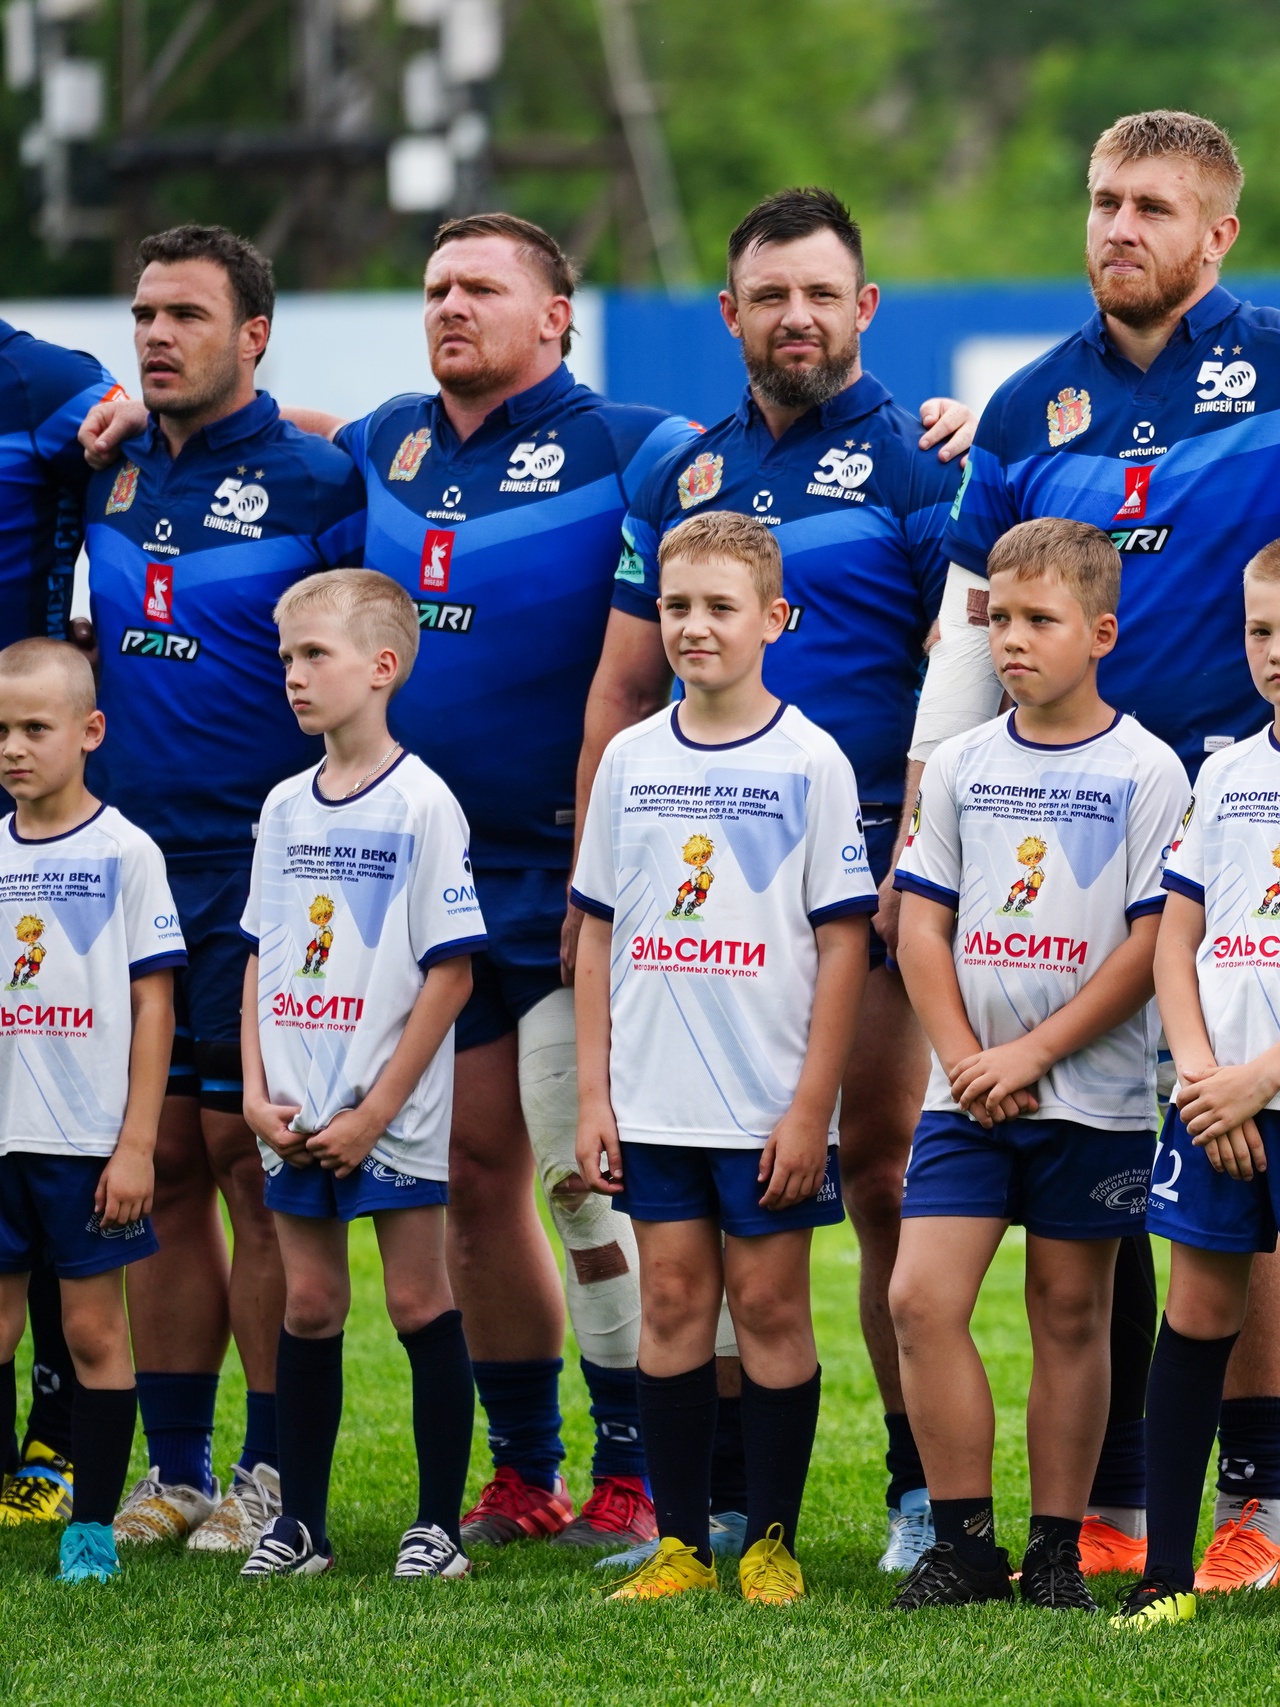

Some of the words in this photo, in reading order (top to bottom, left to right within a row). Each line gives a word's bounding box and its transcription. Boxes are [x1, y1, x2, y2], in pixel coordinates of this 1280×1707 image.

[1197, 360, 1257, 400] 50
[1194, 398, 1233, 414] ЕНИСЕЙ
[1234, 400, 1255, 413] СТМ
[1119, 445, 1167, 459] centurion
[507, 442, 565, 480] 50
[814, 448, 873, 489] 50
[499, 479, 537, 492] ЕНИСЕЙ
[538, 479, 561, 492] СТМ
[806, 482, 843, 499] ЕНИСЕЙ
[844, 490, 866, 503] СТМ
[210, 477, 269, 522] 50
[426, 509, 466, 522] centurion
[203, 513, 240, 534] ЕНИСЕЙ
[240, 526, 262, 540] СТМ
[142, 541, 180, 556] centurion
[423, 578, 444, 587] ПОБЕДА!
[121, 629, 198, 660] PARI
[630, 785, 711, 797] ПОКОЛЕНИЕ
[714, 786, 738, 797] XXI
[742, 787, 780, 801] ВЕКА
[969, 783, 1047, 799] ОКОЛЕНИЕ
[1075, 790, 1112, 805] ВЕКА
[739, 801, 766, 809] ПРИЗЫ
[983, 798, 1023, 807] ФЕСТИВАЛЬ
[1071, 804, 1098, 812] ПРИЗЫ
[677, 806, 708, 814] ТРЕНЕРА
[737, 809, 783, 820] КИЧАЙКИНА
[1012, 808, 1042, 816] ТРЕНЕРА
[1070, 811, 1114, 823] КИЧАЙКИНА
[334, 846, 357, 858] XXI
[361, 849, 397, 863] ВЕКА
[358, 863, 385, 872] ПРИЗЫ
[42, 872, 64, 882] XXI
[69, 872, 101, 884] ВЕКА
[631, 935, 766, 967] ЭЛЬСИТИ
[660, 963, 709, 975] любимых
[711, 966, 758, 978] покупок
[988, 958, 1036, 970] любимых
[45, 1029, 88, 1039] покупок
[395, 1178, 417, 1187] ВЕКА
[1089, 1169, 1130, 1200] регбийный
[1132, 1168, 1151, 1176] клуб
[1095, 1176, 1148, 1202] ПОКОЛЕНИЕ
[816, 1192, 837, 1202] ВЕКА
[124, 1227, 146, 1240] ВЕКА
